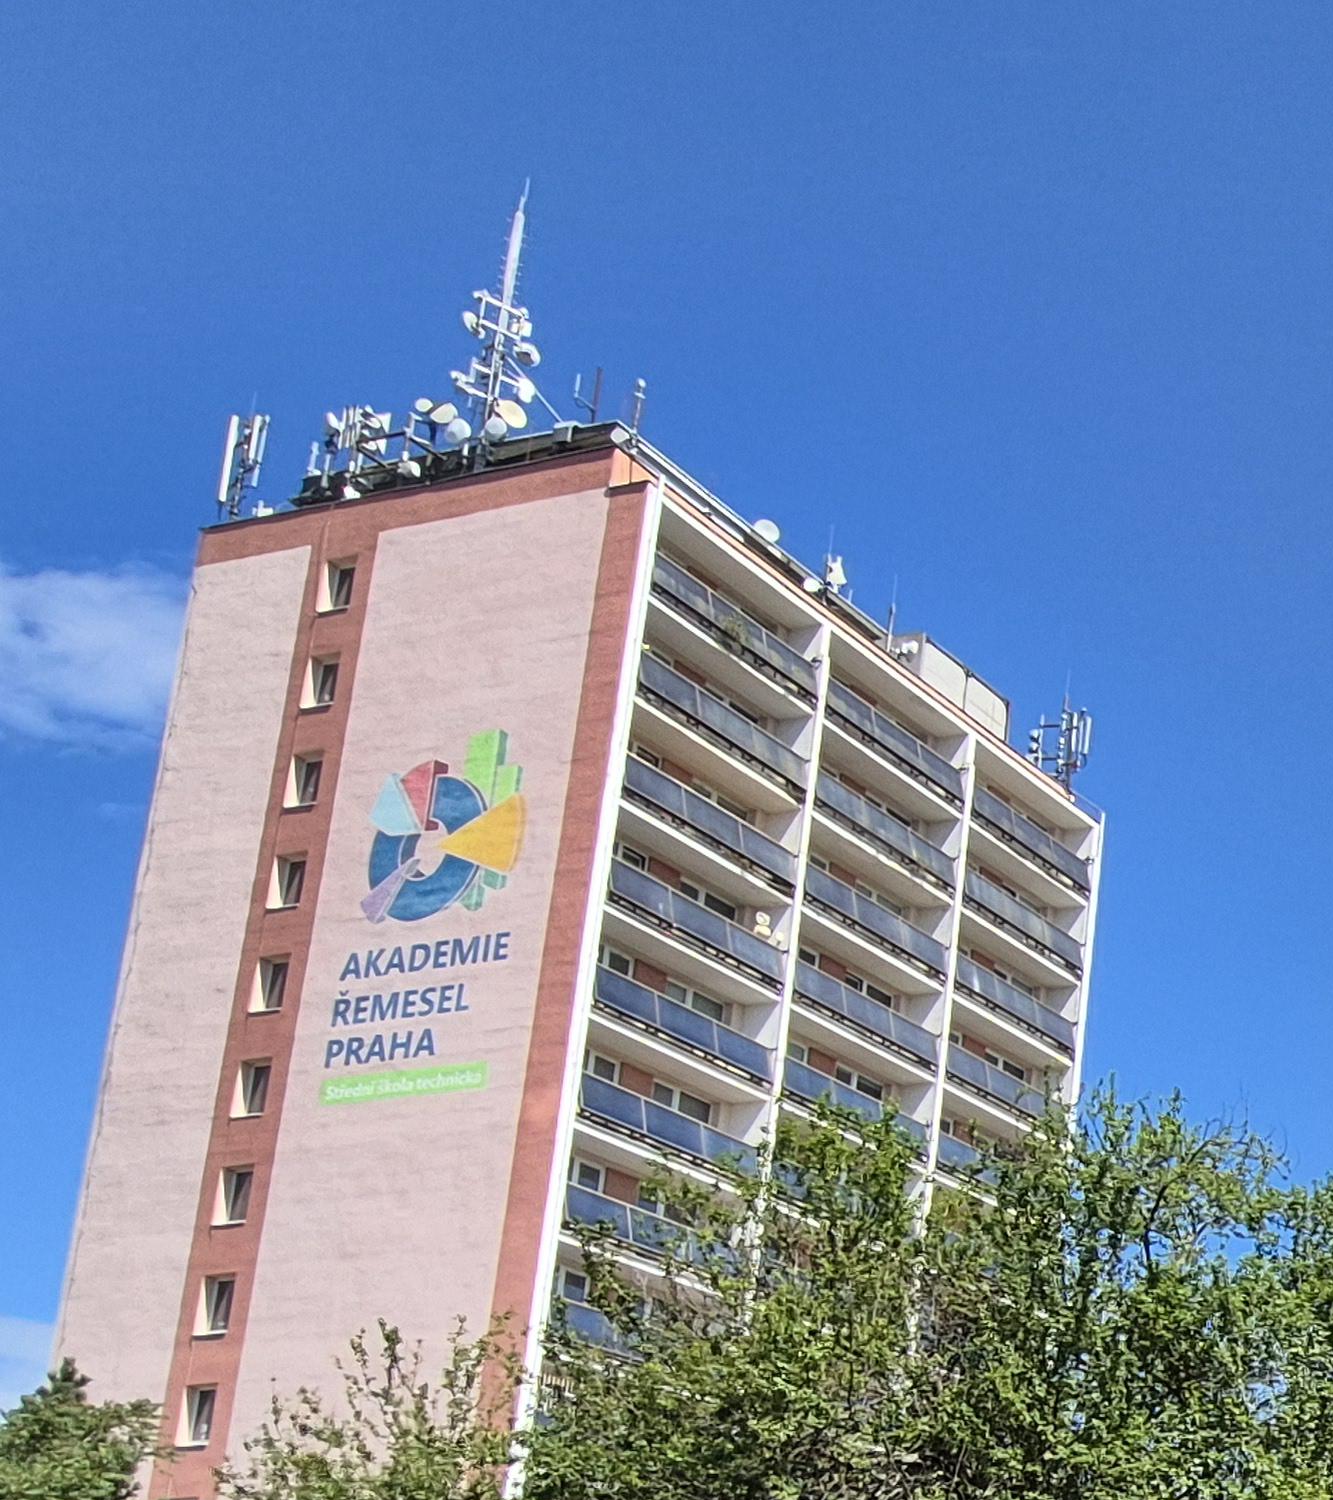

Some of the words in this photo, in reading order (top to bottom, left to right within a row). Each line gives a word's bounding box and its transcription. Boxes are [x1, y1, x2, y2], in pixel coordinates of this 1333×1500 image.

[339, 931, 511, 981] AKADEMIE
[330, 983, 469, 1027] ŘEMESEL
[324, 1028, 436, 1069] PRAHA
